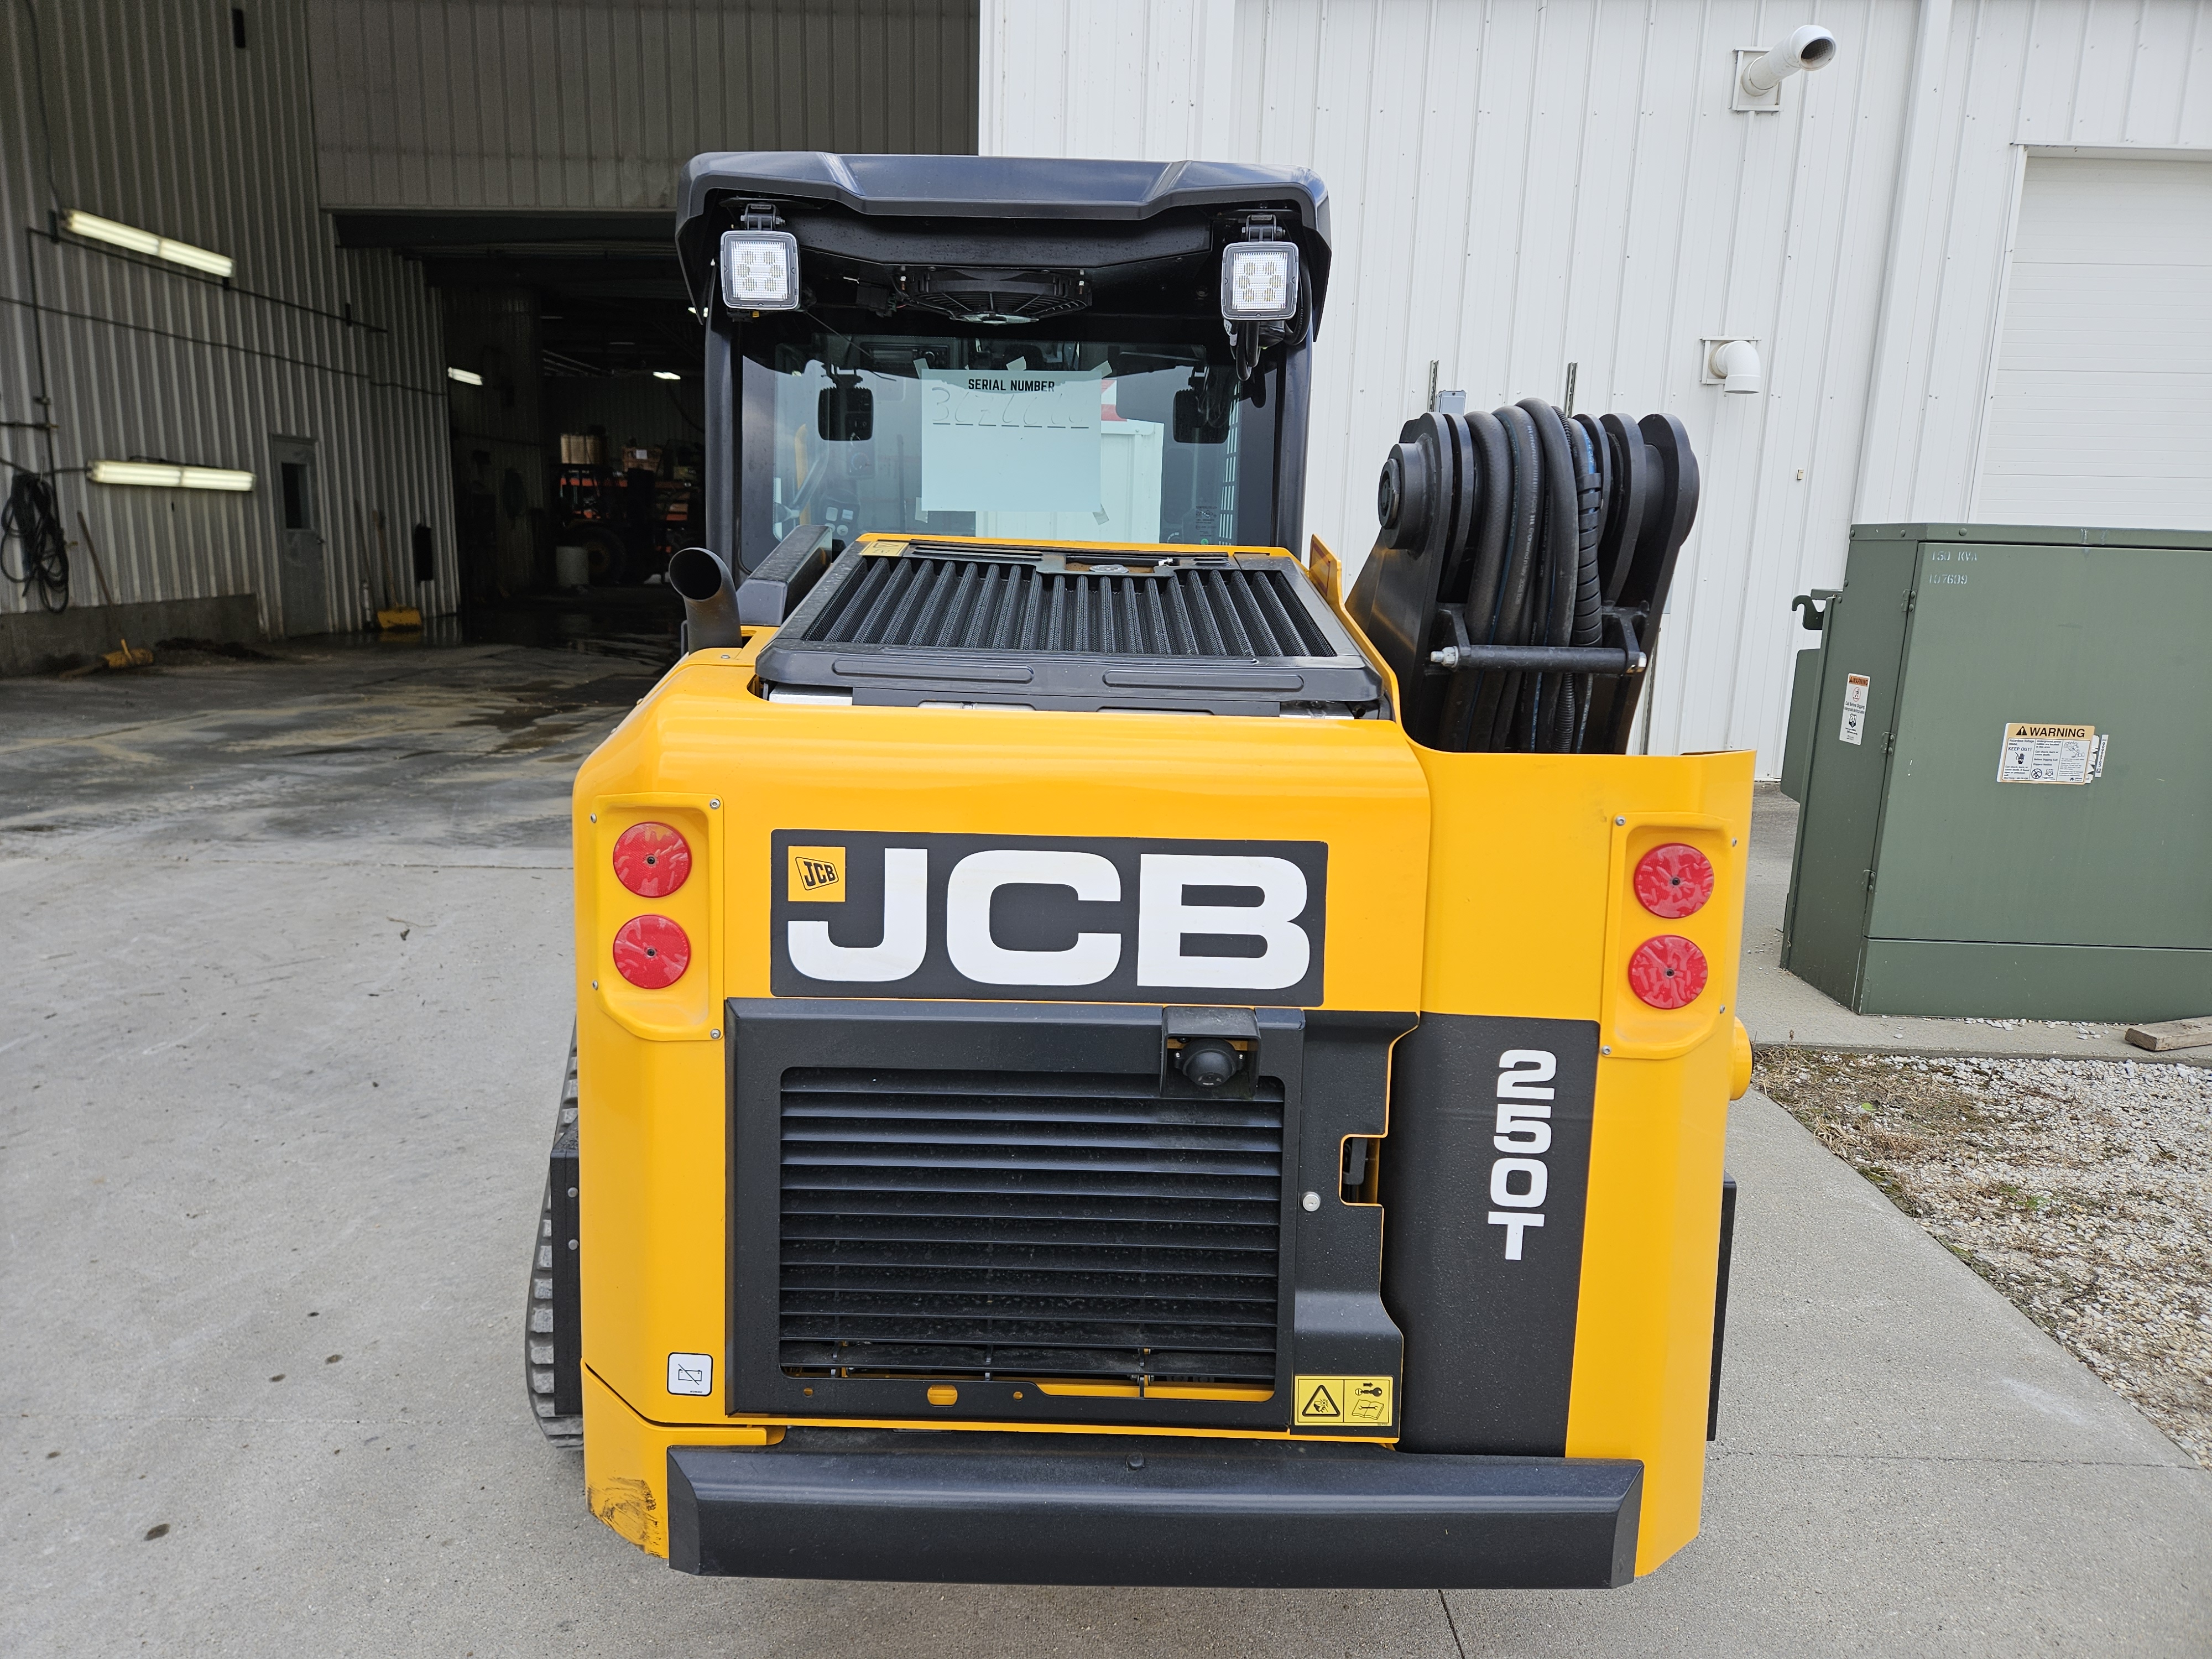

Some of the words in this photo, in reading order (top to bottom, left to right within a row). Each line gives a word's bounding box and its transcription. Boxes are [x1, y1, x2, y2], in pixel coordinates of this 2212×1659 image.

[968, 379, 1006, 390] SERIAL
[1010, 379, 1055, 392] NUMBER
[1932, 551, 1951, 561] 150
[1958, 551, 1978, 561] KVA
[1929, 574, 1968, 585] 107609
[1853, 677, 1868, 686] WARNING
[2030, 727, 2085, 737] WARNING
[804, 860, 836, 886] JCB
[787, 847, 1310, 989] JCB
[1488, 1049, 1557, 1260] 250T
